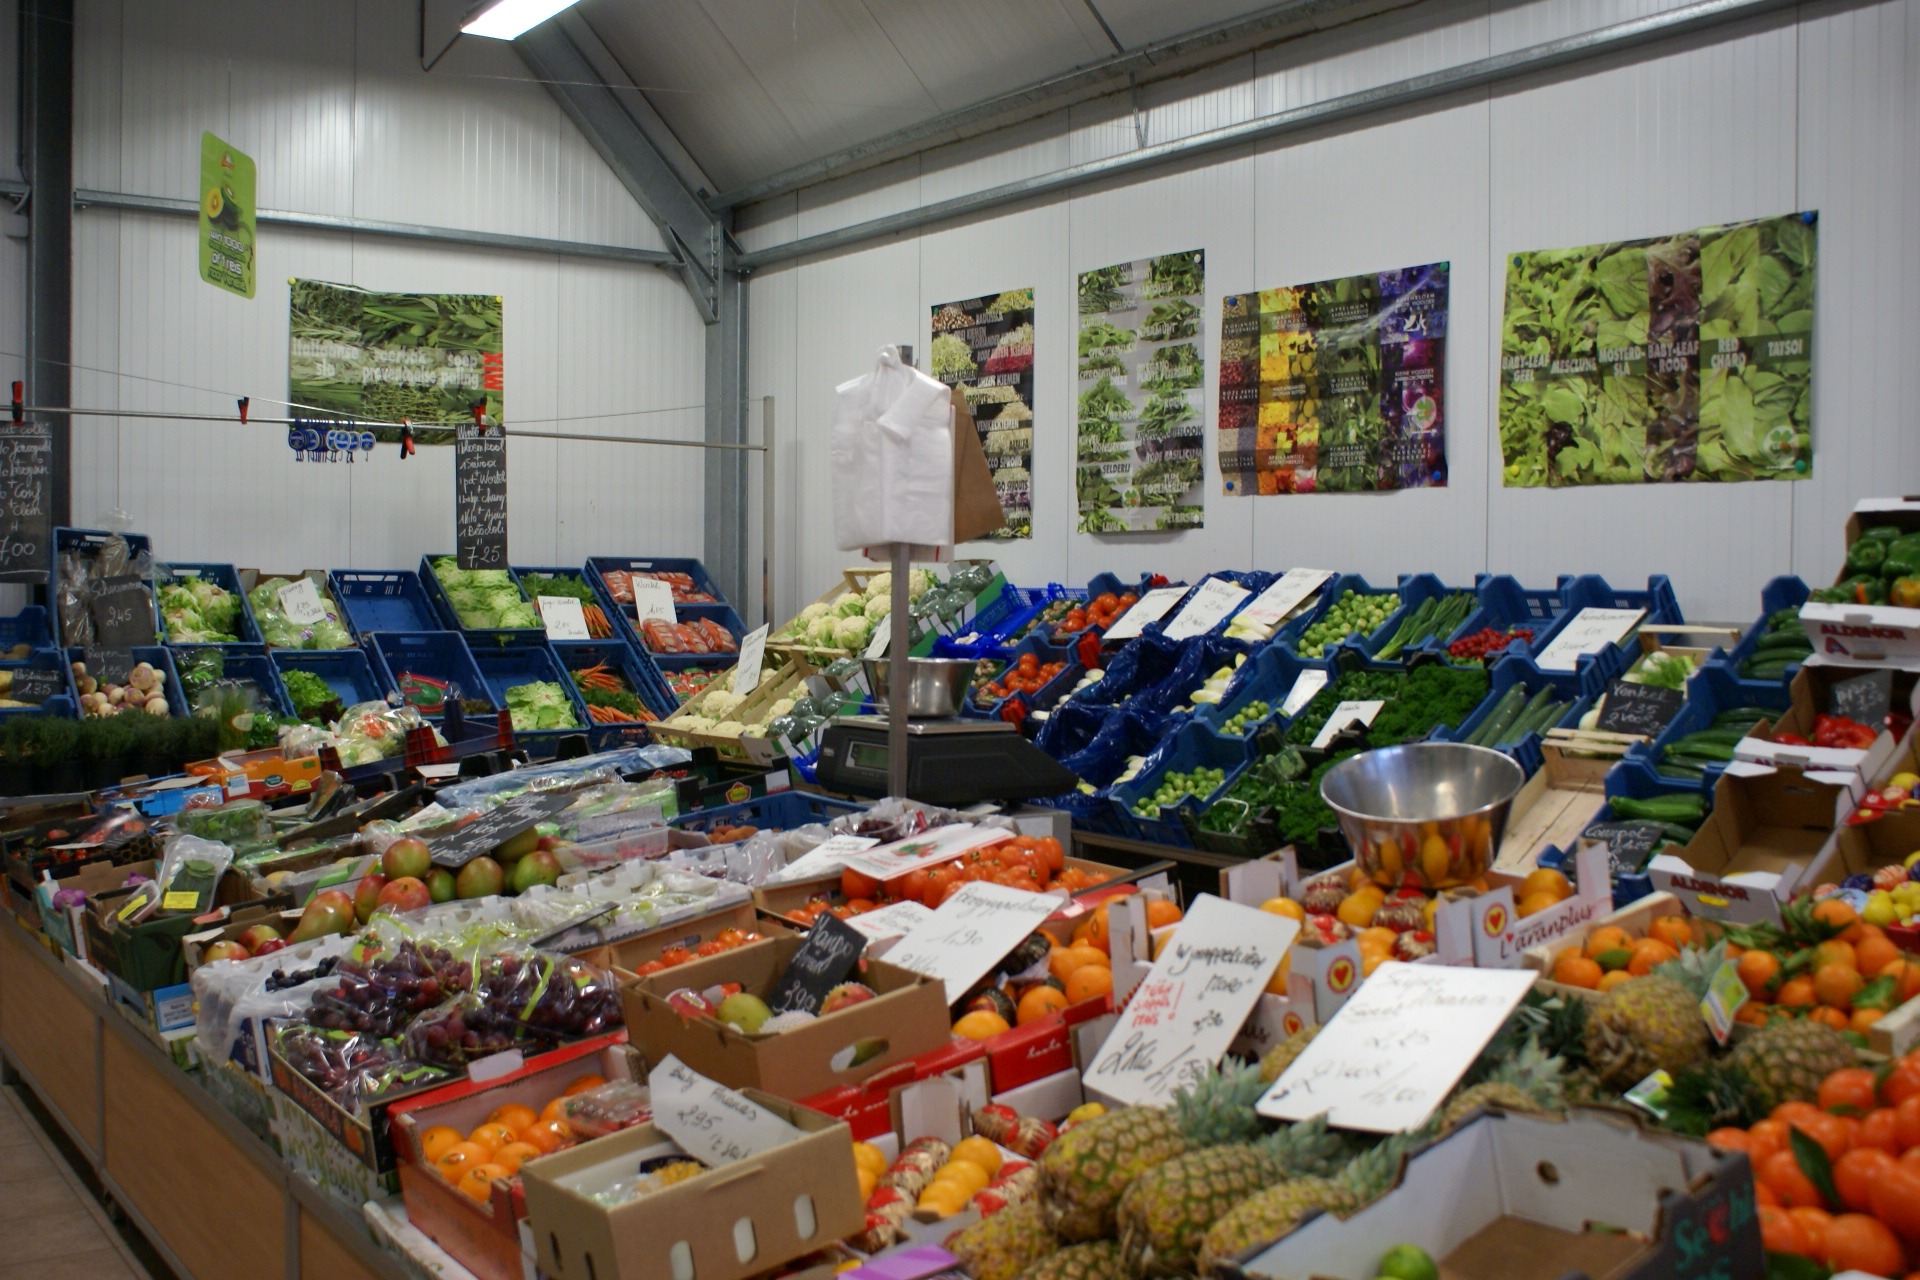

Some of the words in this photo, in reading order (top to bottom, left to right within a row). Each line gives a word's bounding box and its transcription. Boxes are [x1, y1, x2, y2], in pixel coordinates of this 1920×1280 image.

[1648, 340, 1699, 358] BABY-LEAF
[1718, 338, 1740, 352] RED
[1768, 339, 1803, 357] TATSOI
[447, 353, 478, 372] soep
[1502, 352, 1550, 370] BABY-LEAF
[1599, 346, 1646, 363] MOSTERD-
[1711, 352, 1746, 369] CHARD
[482, 352, 504, 391] MIX
[1613, 362, 1631, 376] SLA
[1659, 357, 1688, 373] ROOD
[1514, 369, 1535, 382] GEEL
[1102, 463, 1131, 474] SELDERIJ
[464, 545, 501, 569] 7,25
[1820, 623, 1906, 640] ALDENOR
[1670, 874, 1749, 901] ALDENOR
[677, 1105, 723, 1130] 2,95
